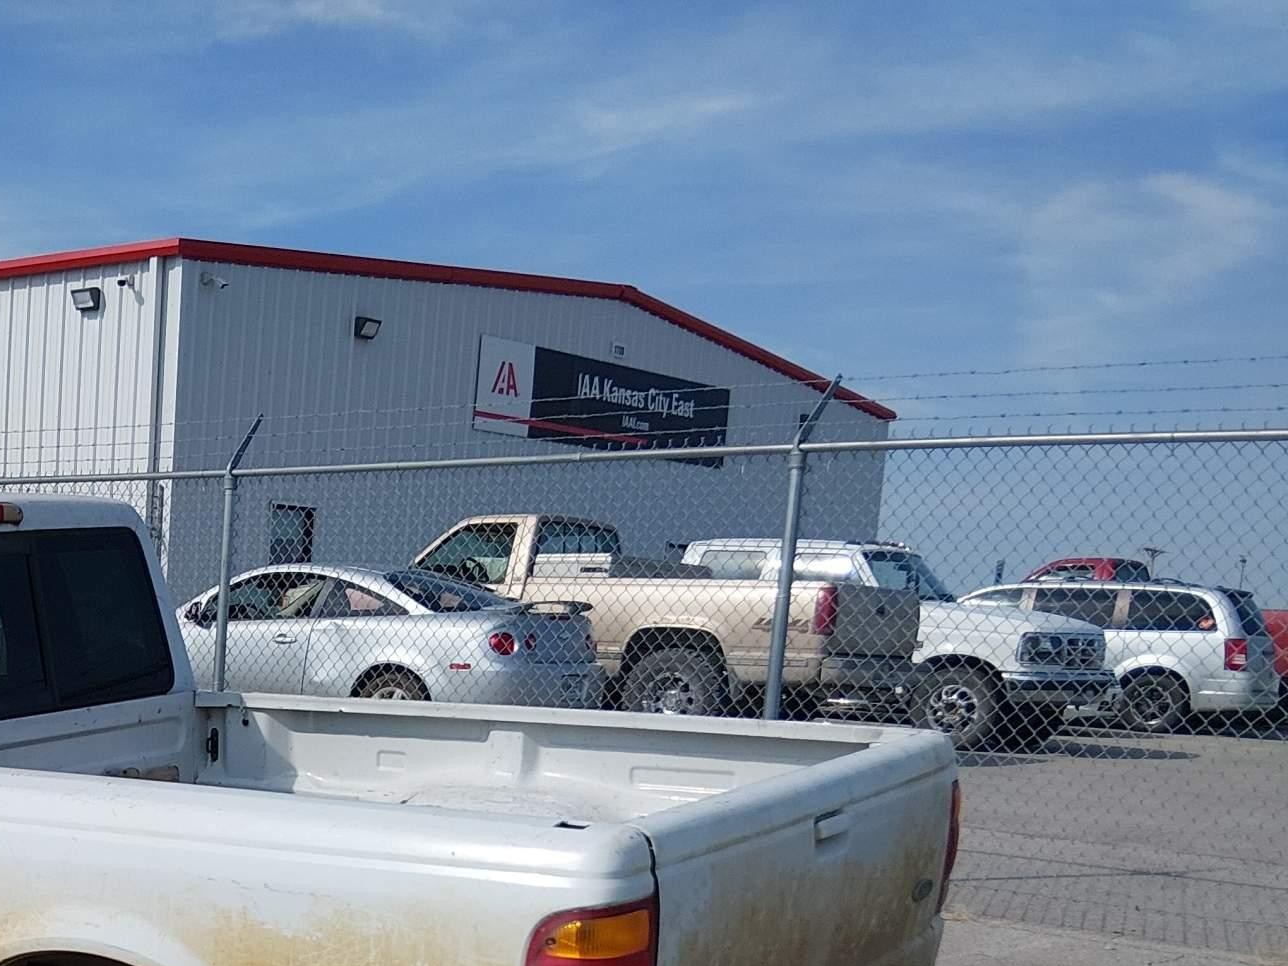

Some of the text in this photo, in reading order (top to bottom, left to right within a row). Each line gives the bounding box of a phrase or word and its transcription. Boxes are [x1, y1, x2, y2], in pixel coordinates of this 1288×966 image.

[576, 373, 695, 418] IAA Kansas City East
